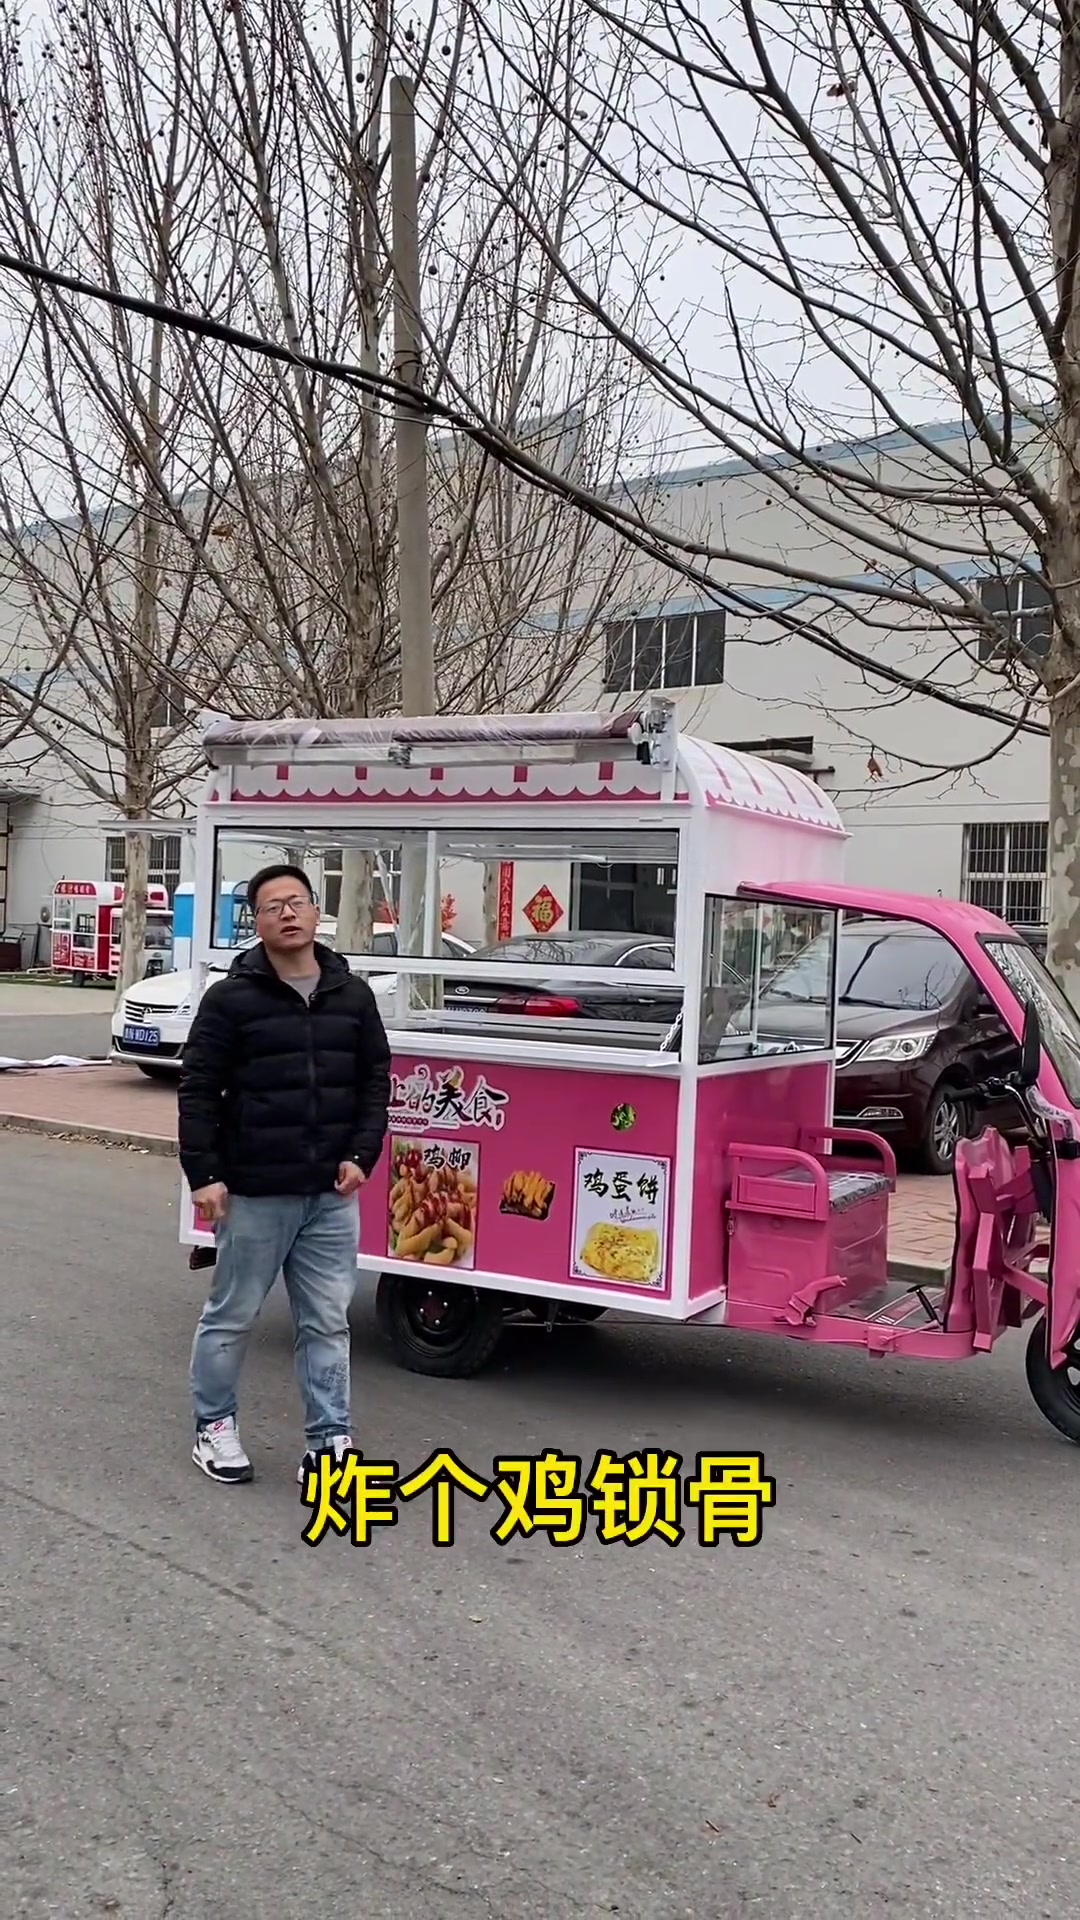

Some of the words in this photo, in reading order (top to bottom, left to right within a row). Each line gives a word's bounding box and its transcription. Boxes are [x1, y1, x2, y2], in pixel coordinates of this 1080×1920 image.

[531, 895, 554, 924] 福
[583, 1167, 659, 1205] 鸡蛋饼
